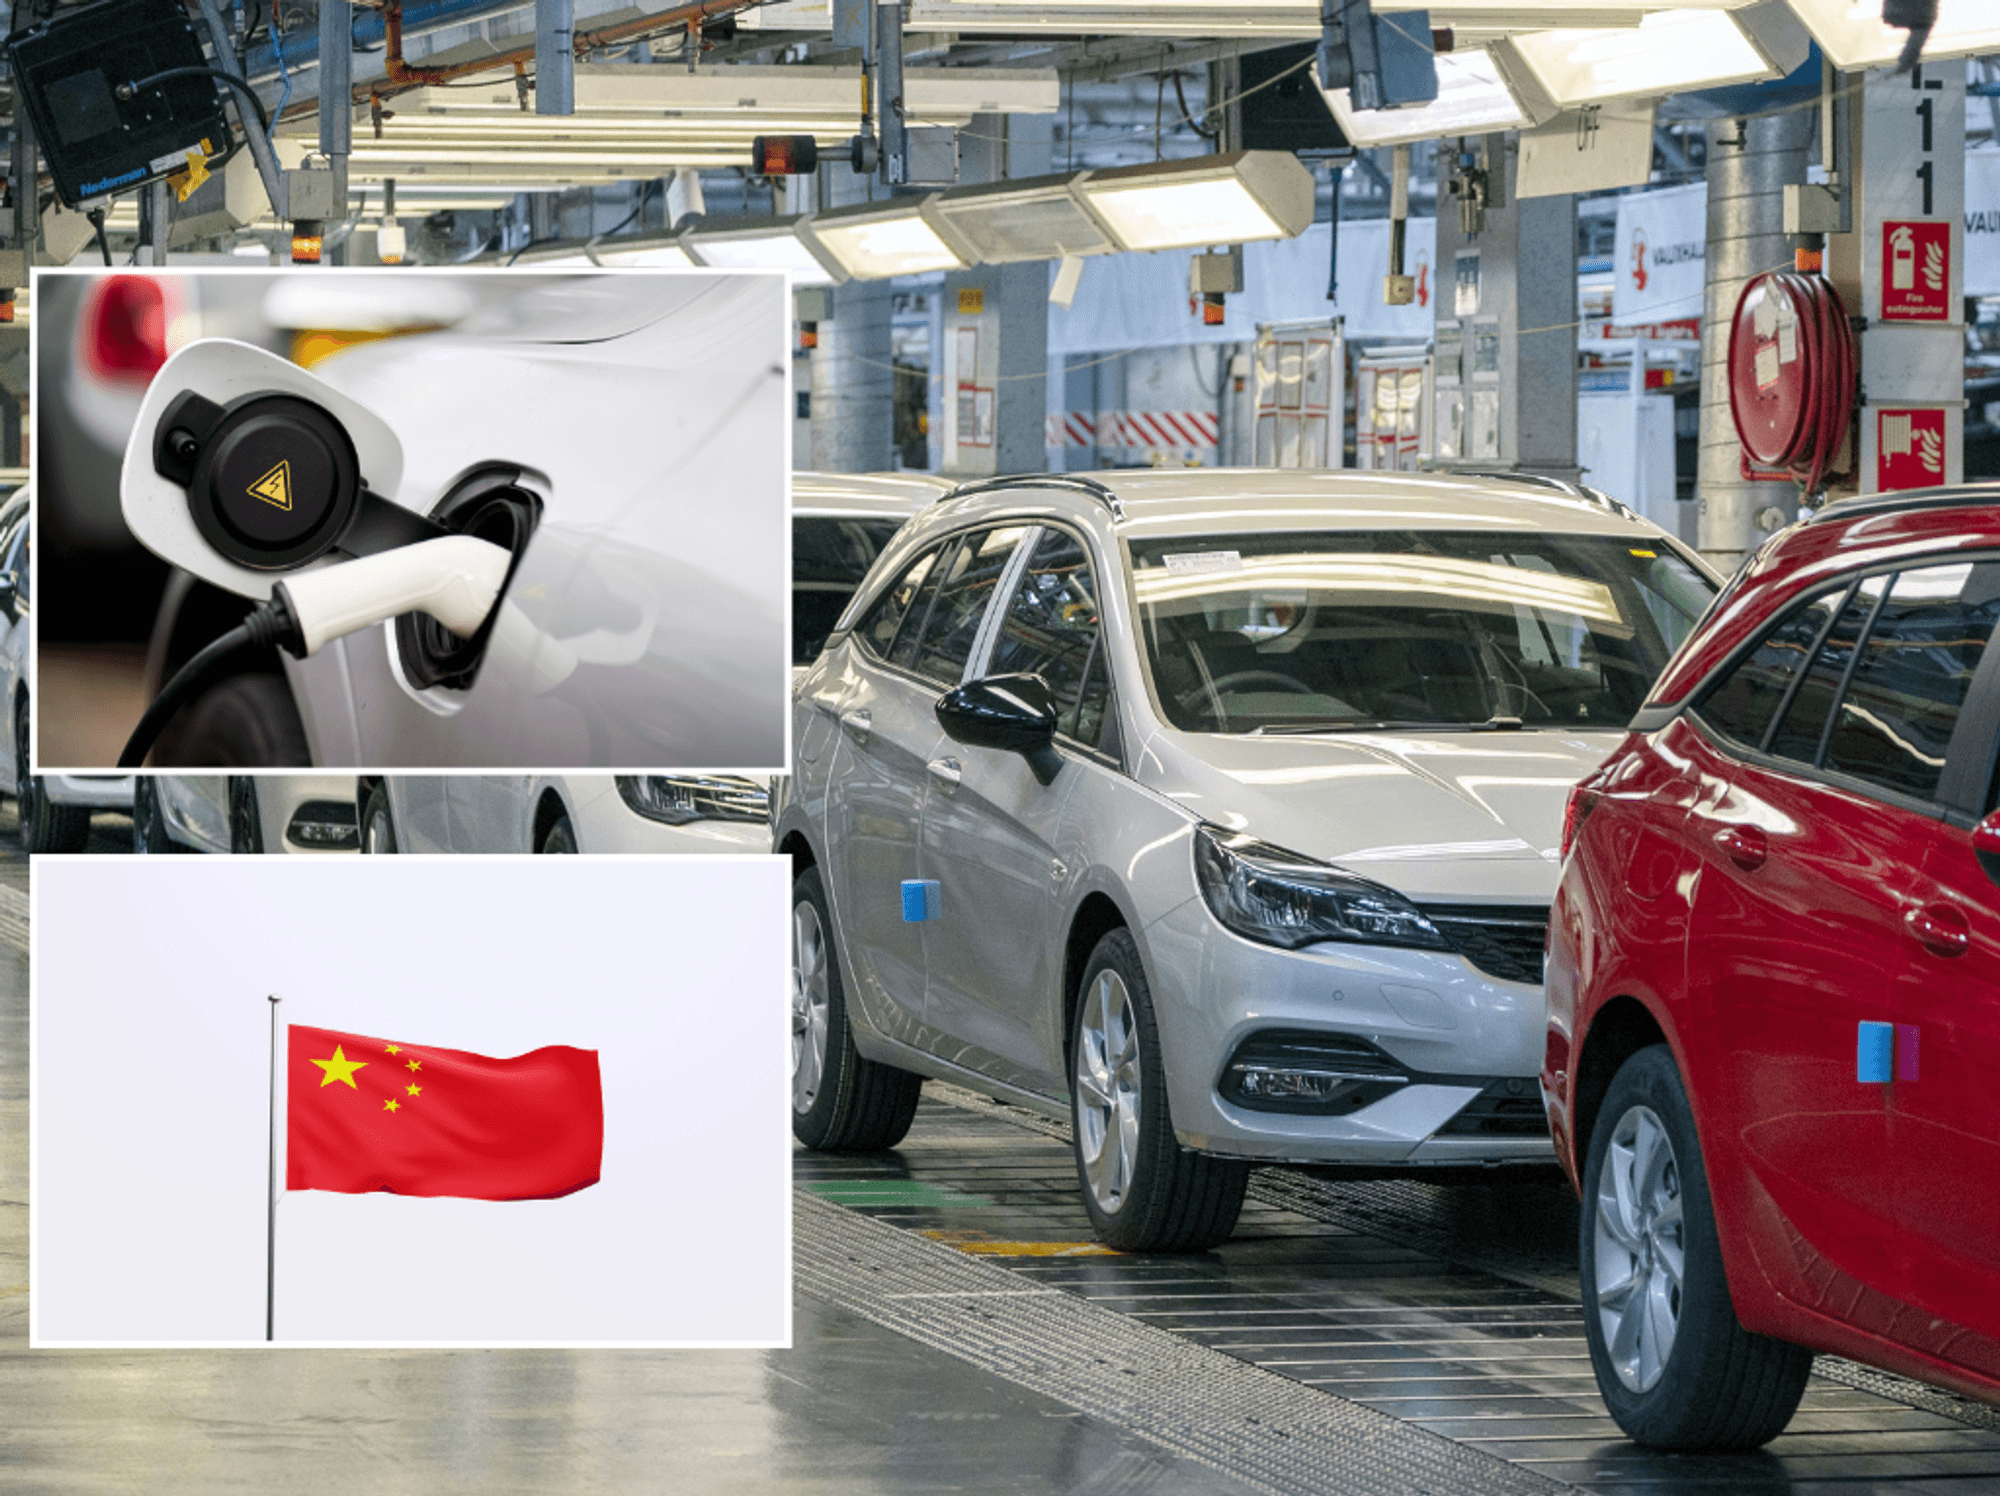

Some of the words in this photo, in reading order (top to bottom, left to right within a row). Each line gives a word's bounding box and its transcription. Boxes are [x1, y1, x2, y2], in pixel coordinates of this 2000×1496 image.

[80, 167, 147, 197] Nederman
[1963, 210, 2000, 234] VAU
[1906, 293, 1924, 303] Fire
